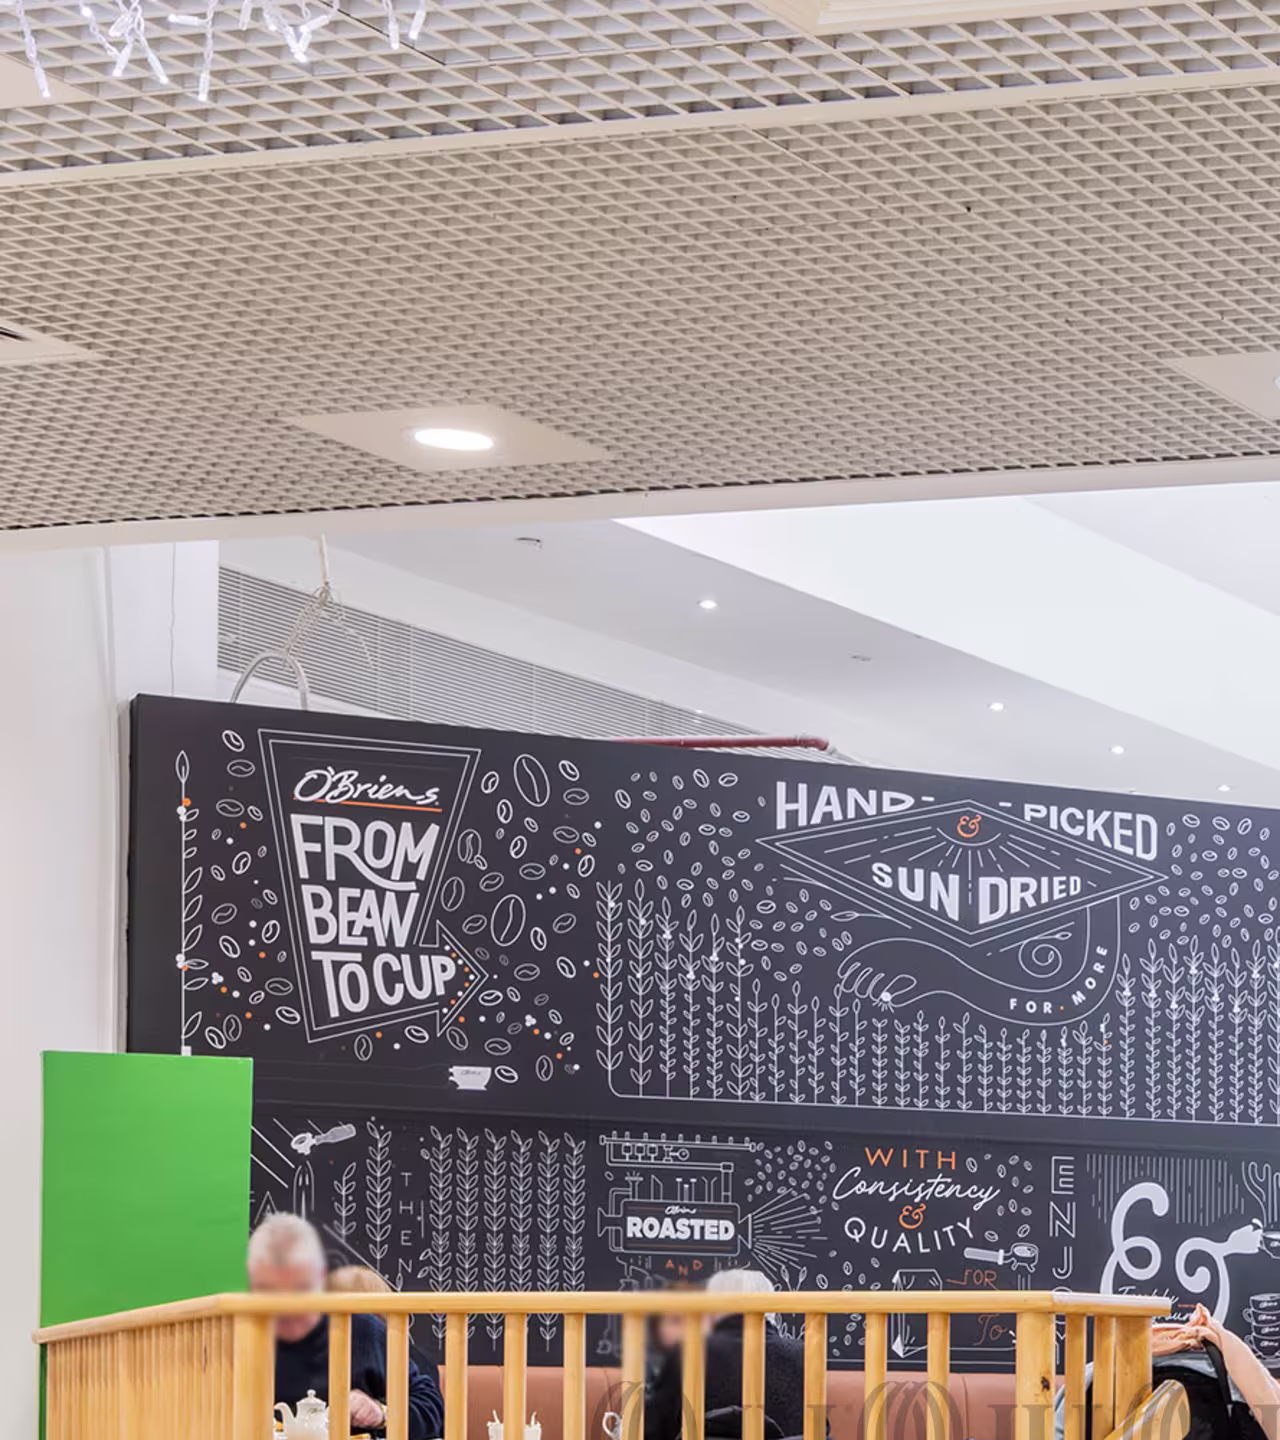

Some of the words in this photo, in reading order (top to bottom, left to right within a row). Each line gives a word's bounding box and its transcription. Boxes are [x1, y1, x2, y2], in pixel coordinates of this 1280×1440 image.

[294, 766, 440, 805] O'Briens
[957, 814, 982, 838] &
[290, 812, 440, 890] FROM
[871, 862, 959, 921] SUN
[978, 874, 1081, 925] DRIED
[301, 884, 419, 946] BEAN
[311, 950, 368, 1018] TO
[374, 954, 456, 1002] CUP
[1010, 998, 1052, 1014] FOR
[1072, 945, 1108, 1006] MORE
[864, 1146, 956, 1170] WITH
[832, 1166, 1000, 1210] Consistency
[627, 1217, 735, 1241] ROASTED
[844, 1216, 975, 1255] QUALITY
[898, 1203, 926, 1230] &
